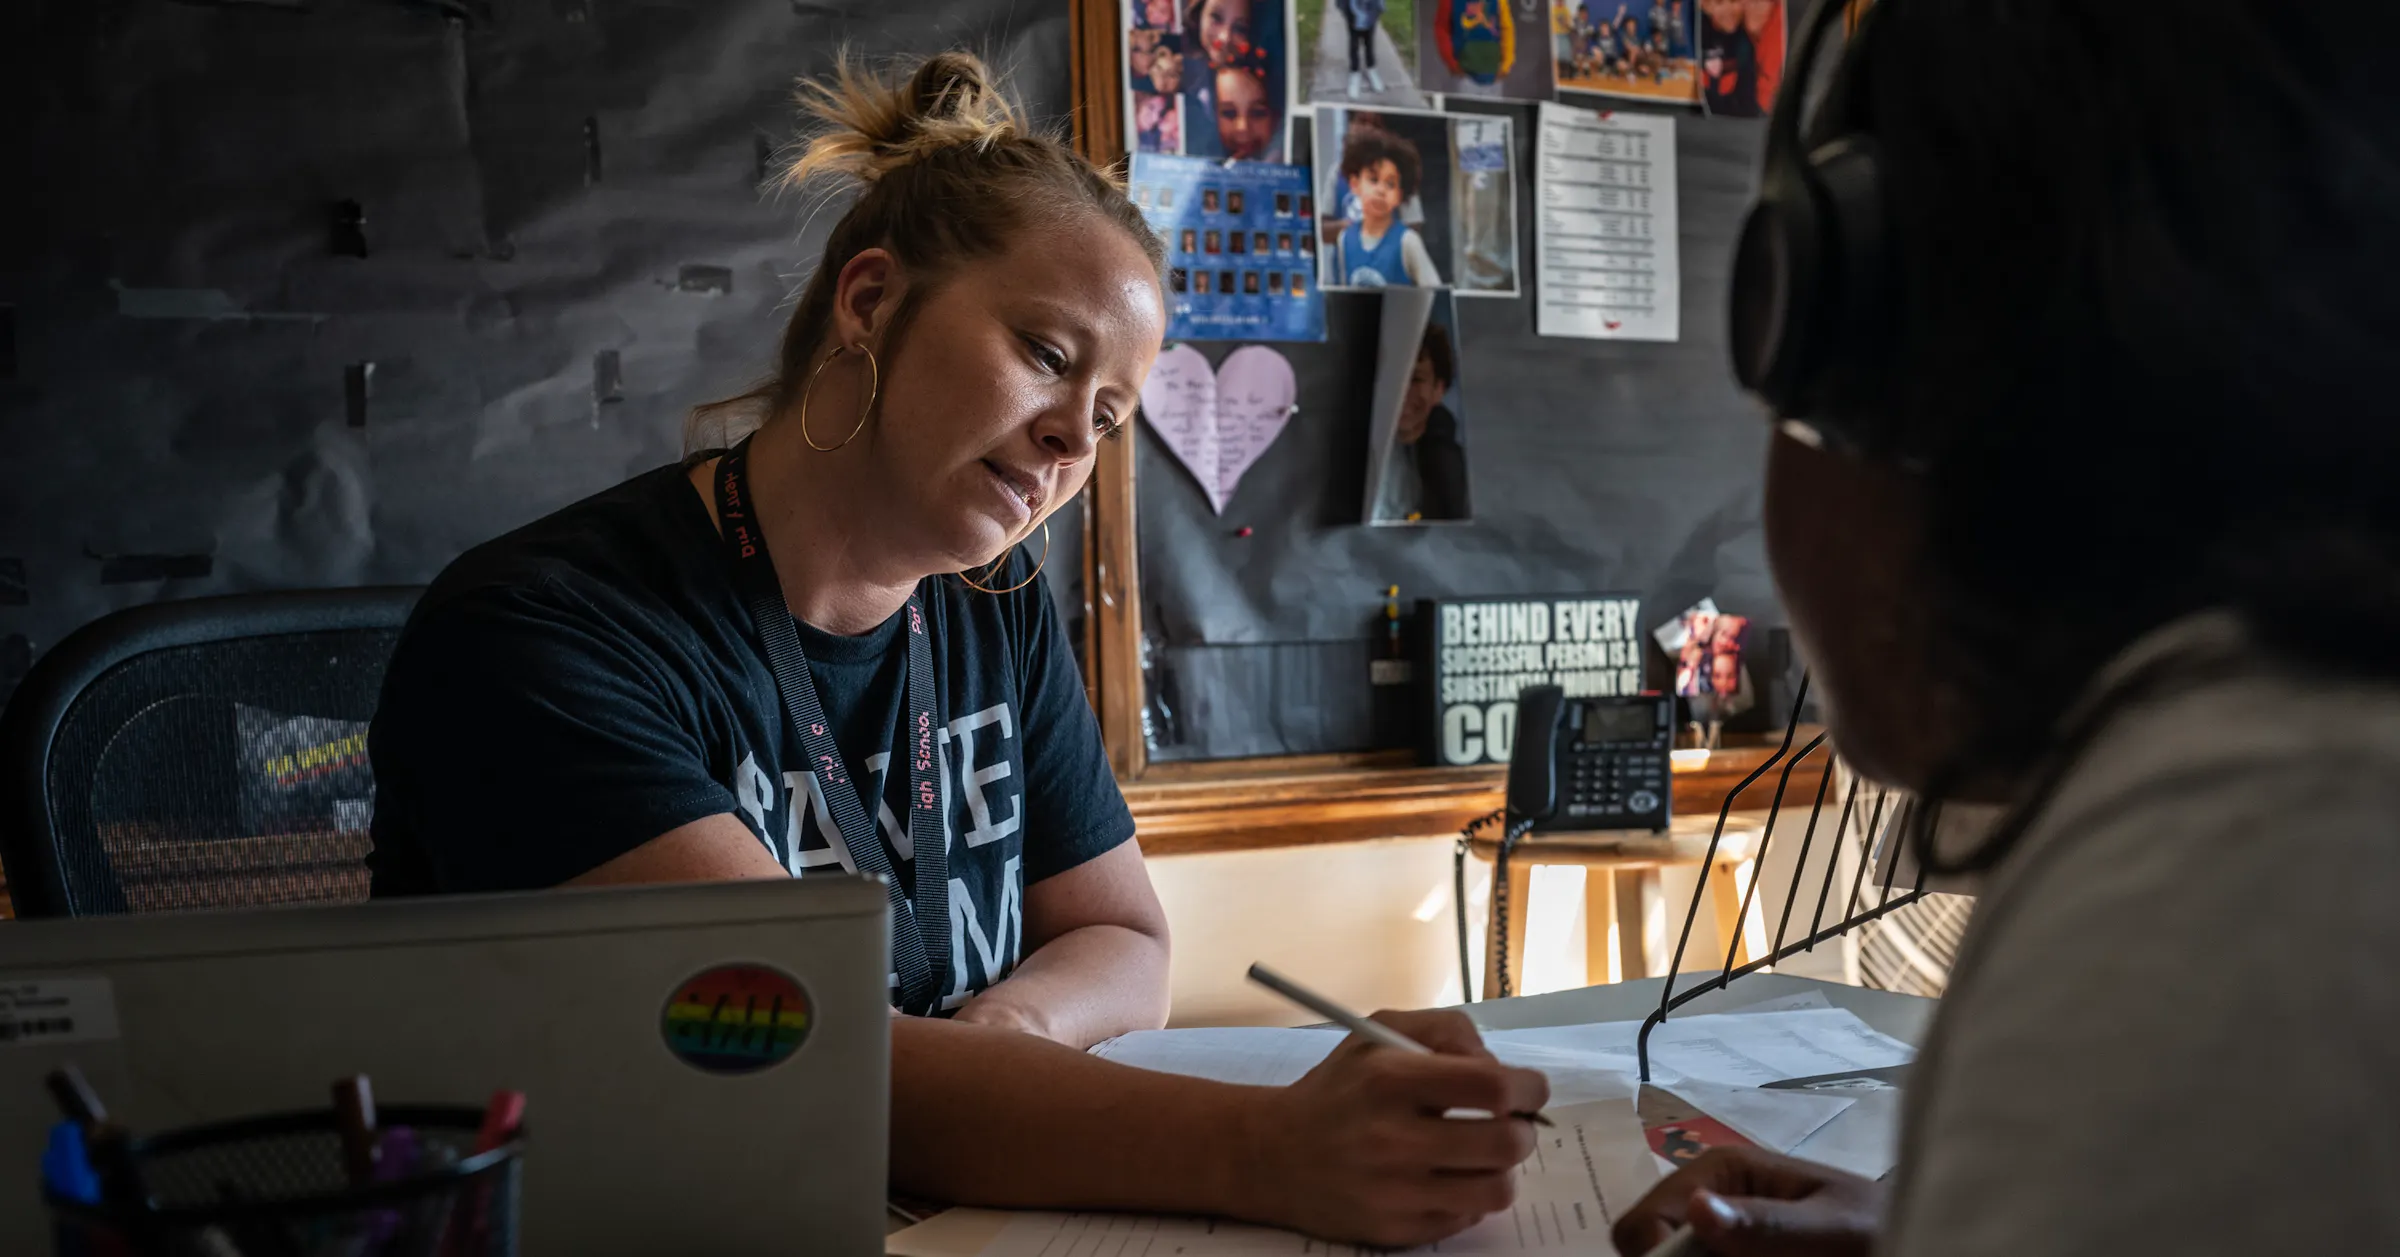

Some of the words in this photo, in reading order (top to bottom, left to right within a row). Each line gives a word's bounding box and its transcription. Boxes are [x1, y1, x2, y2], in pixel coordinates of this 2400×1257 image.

[1441, 602, 1550, 646] BEHIND
[1554, 600, 1640, 642] EVERY
[1441, 643, 1545, 674] SUCCESSFUL
[1546, 641, 1608, 671] PERSON
[1609, 640, 1626, 668] IS
[1627, 639, 1640, 667] A
[1618, 669, 1640, 696] OF
